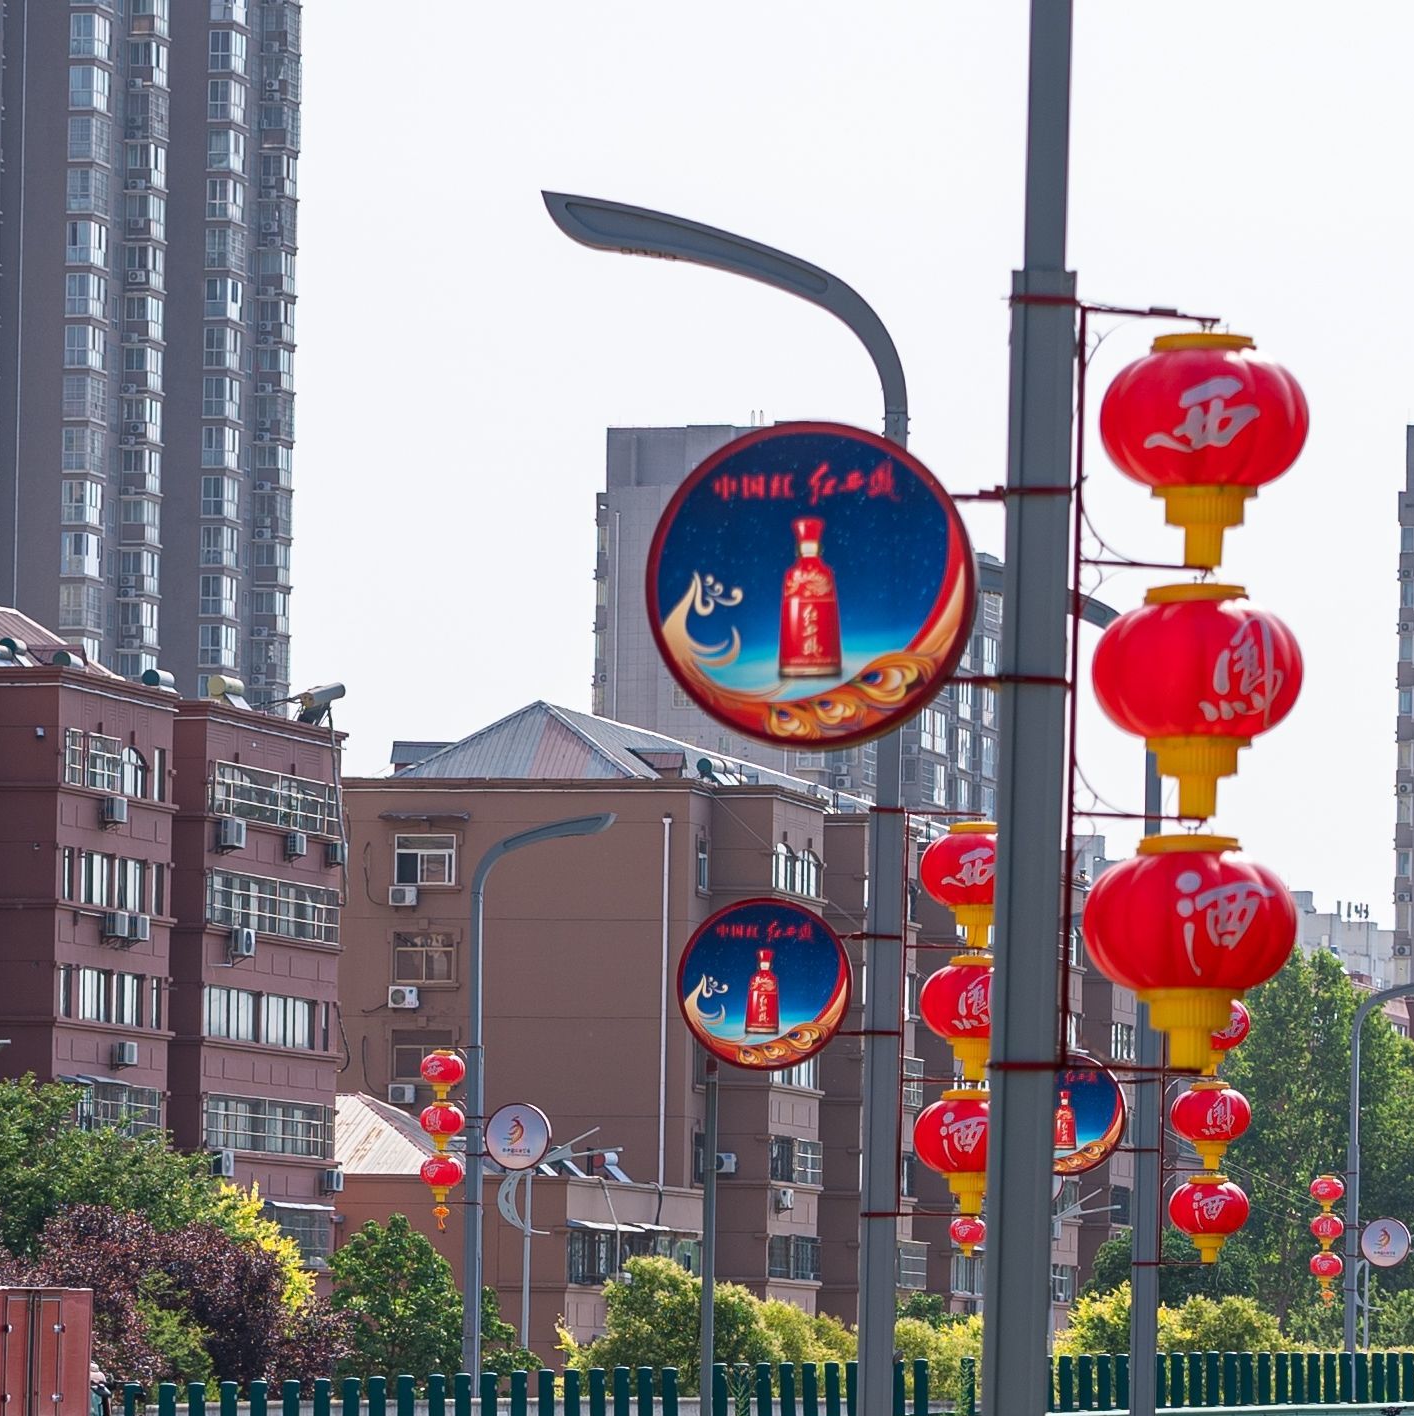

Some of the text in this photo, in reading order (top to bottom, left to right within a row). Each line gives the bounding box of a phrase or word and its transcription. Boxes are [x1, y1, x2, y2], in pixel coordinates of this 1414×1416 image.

[1144, 376, 1260, 452] 西
[1176, 871, 1276, 976] 酒
[1192, 1192, 1233, 1230] 酒
